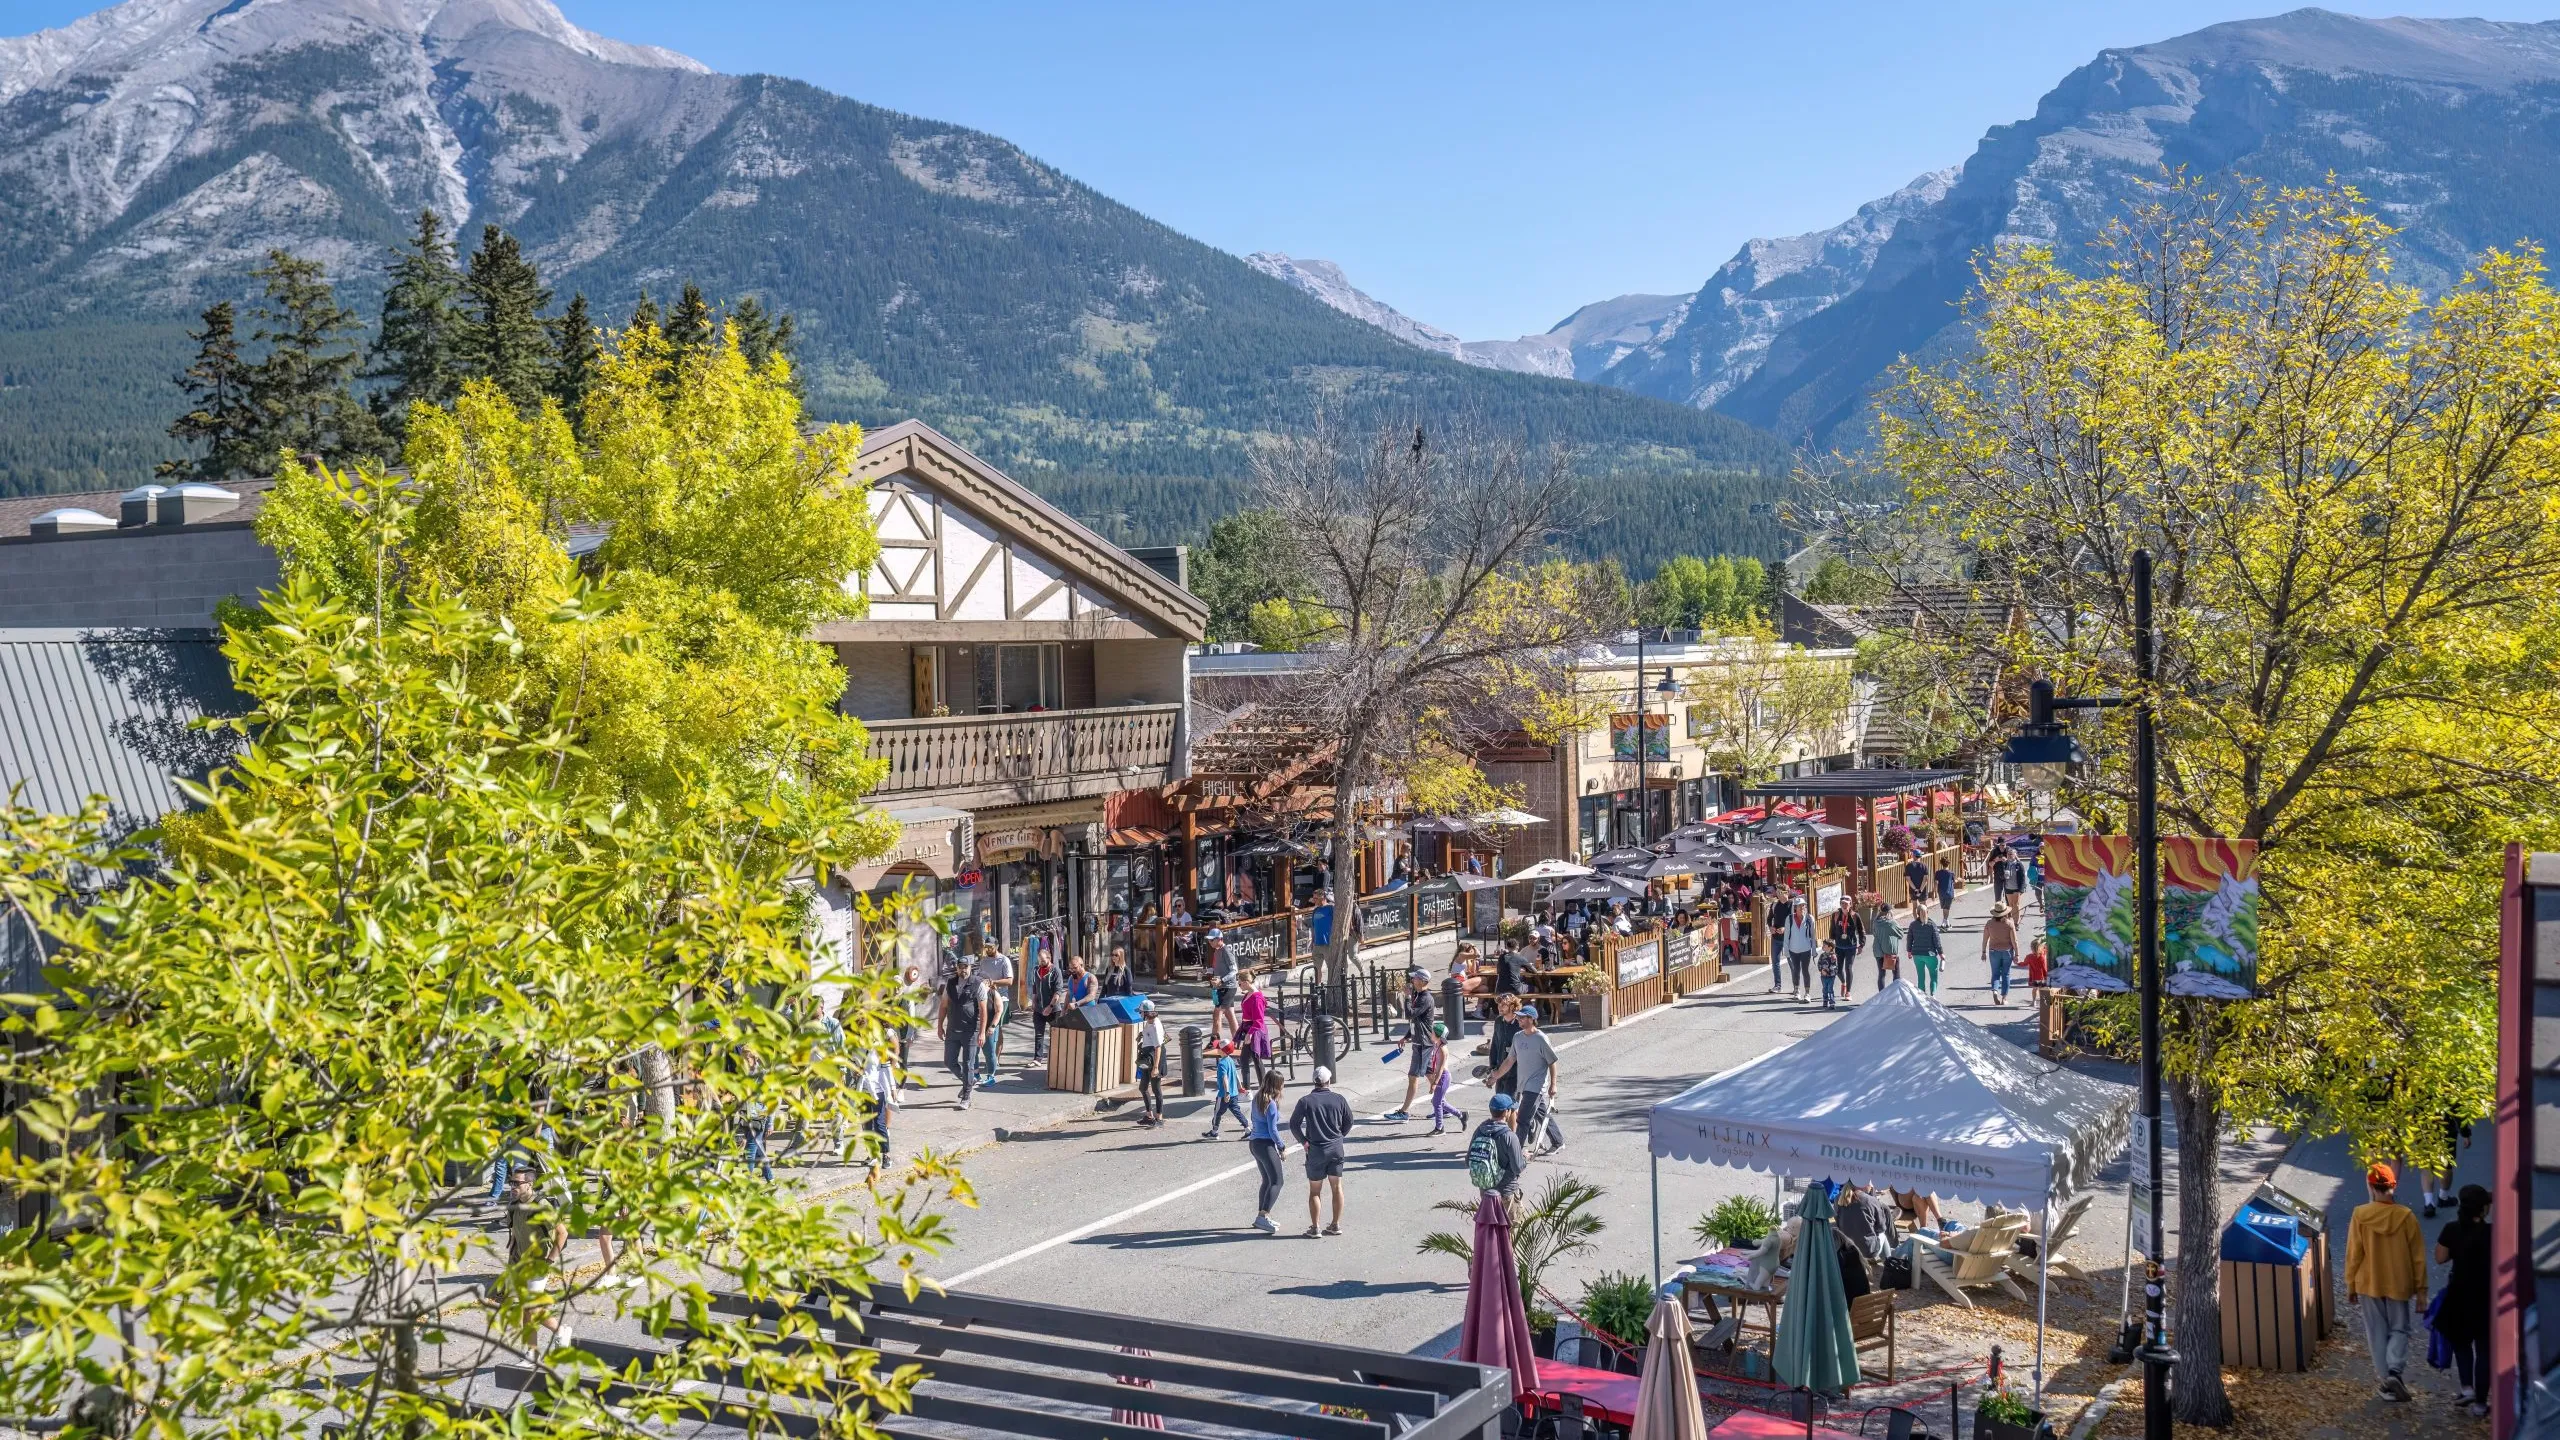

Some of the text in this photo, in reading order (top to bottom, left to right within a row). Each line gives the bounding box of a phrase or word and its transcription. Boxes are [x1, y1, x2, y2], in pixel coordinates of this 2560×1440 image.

[914, 844, 941, 860] MALL
[959, 872, 983, 886] OPEN
[1580, 885, 1611, 893] Asahi
[1423, 897, 1454, 916] PASTRIES
[1368, 909, 1400, 927] LOUNGE
[1697, 1123, 1771, 1149] HIJINX
[1820, 1143, 1924, 1170] mountain
[1932, 1155, 1996, 1179] littles
[1833, 1162, 1864, 1174] BABY
[1881, 1171, 1910, 1181] KIDS
[1915, 1174, 1980, 1190] BOUTIQUE
